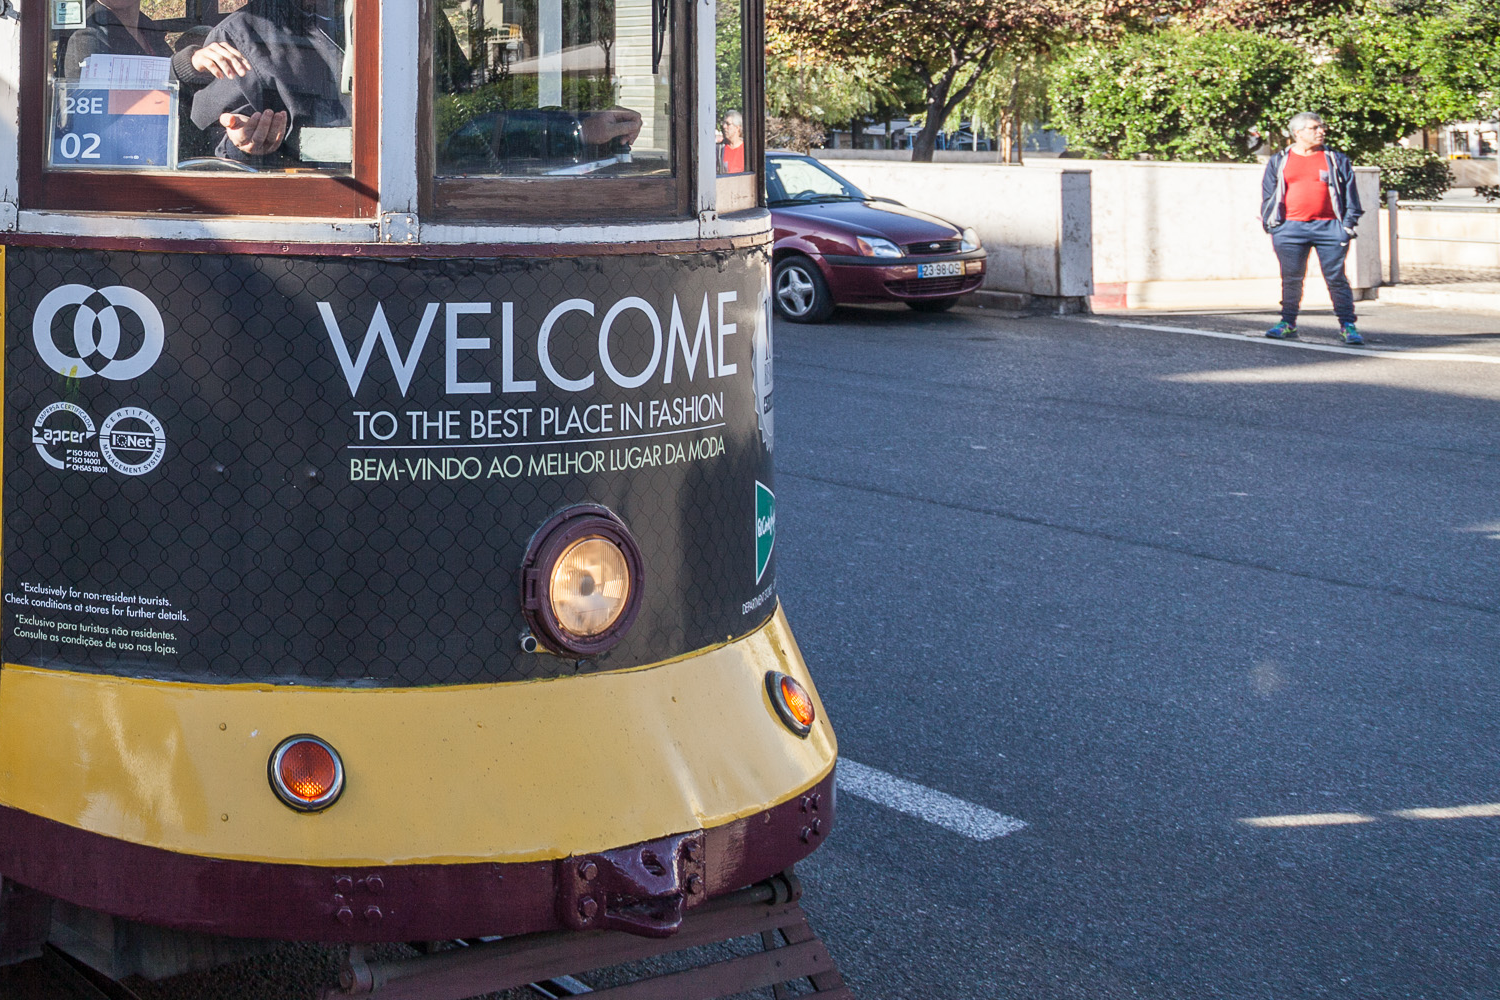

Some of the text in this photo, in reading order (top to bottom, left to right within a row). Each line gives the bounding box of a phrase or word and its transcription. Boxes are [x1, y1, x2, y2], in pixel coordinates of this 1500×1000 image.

[63, 97, 104, 115] 28E
[60, 132, 101, 159] 02
[316, 291, 738, 398] WELCOME
[105, 409, 160, 432] CERTIFIED
[353, 391, 724, 440] TO THE BEST PLACE IN FASHION
[43, 428, 85, 446] apcer
[112, 434, 153, 448] IQNet
[72, 449, 83, 457] ISO
[72, 456, 83, 464] ISO
[350, 435, 726, 482] BEM-VINDO AO MELHOR LUGAR DA MODA
[4, 593, 190, 622] Check conditions at stores for further details.
[69, 587, 82, 598] for
[83, 592, 137, 604] non-resident
[138, 596, 172, 607] tourists.
[13, 628, 179, 655] Consulte as condições de uso nas lojas.
[57, 622, 78, 632] para
[79, 623, 109, 635] turistas
[111, 626, 129, 637] não
[131, 628, 178, 641] residentes.
